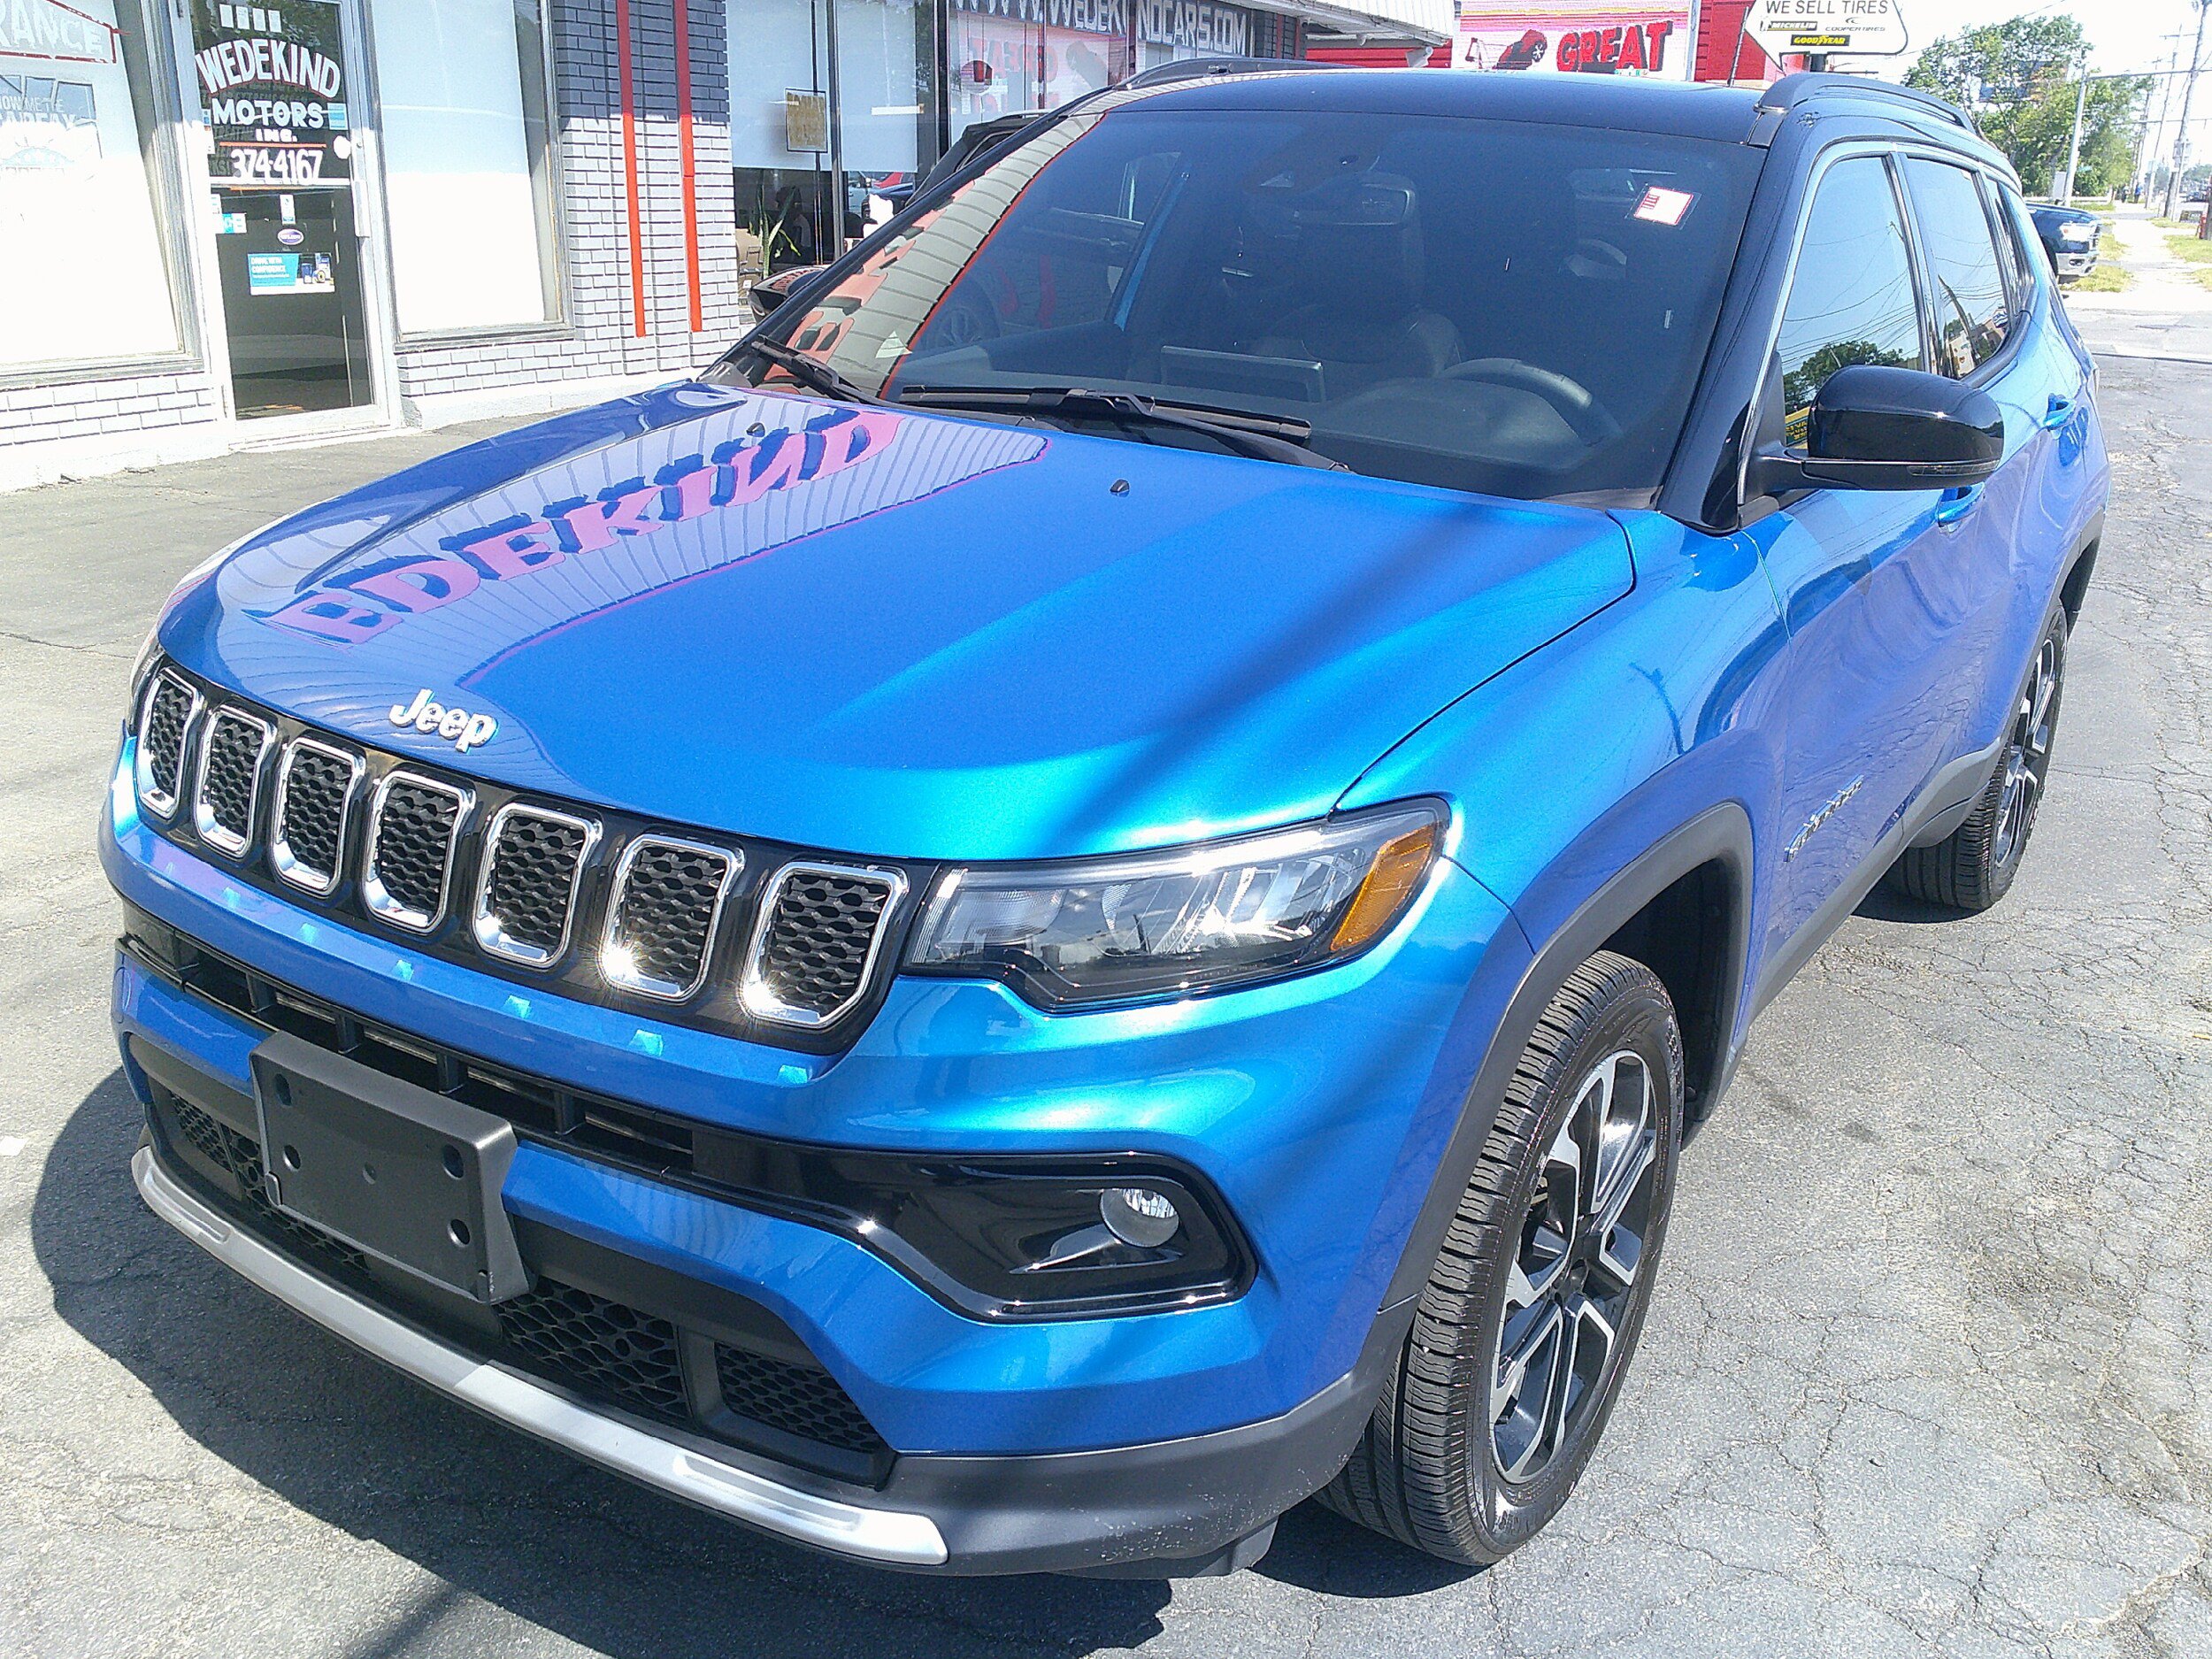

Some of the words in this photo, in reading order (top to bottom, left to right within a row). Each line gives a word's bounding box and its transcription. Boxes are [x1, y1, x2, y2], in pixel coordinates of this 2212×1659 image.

[1766, 0, 1790, 13] WE
[1795, 0, 1835, 13] SELL
[1843, 0, 1888, 13] TIRES
[1556, 21, 1671, 72] GREAT
[1793, 35, 1845, 45] GOODYEAR
[195, 38, 342, 99] WEDEKIND
[211, 98, 324, 128] MOTORS
[389, 689, 498, 753] Jeep
